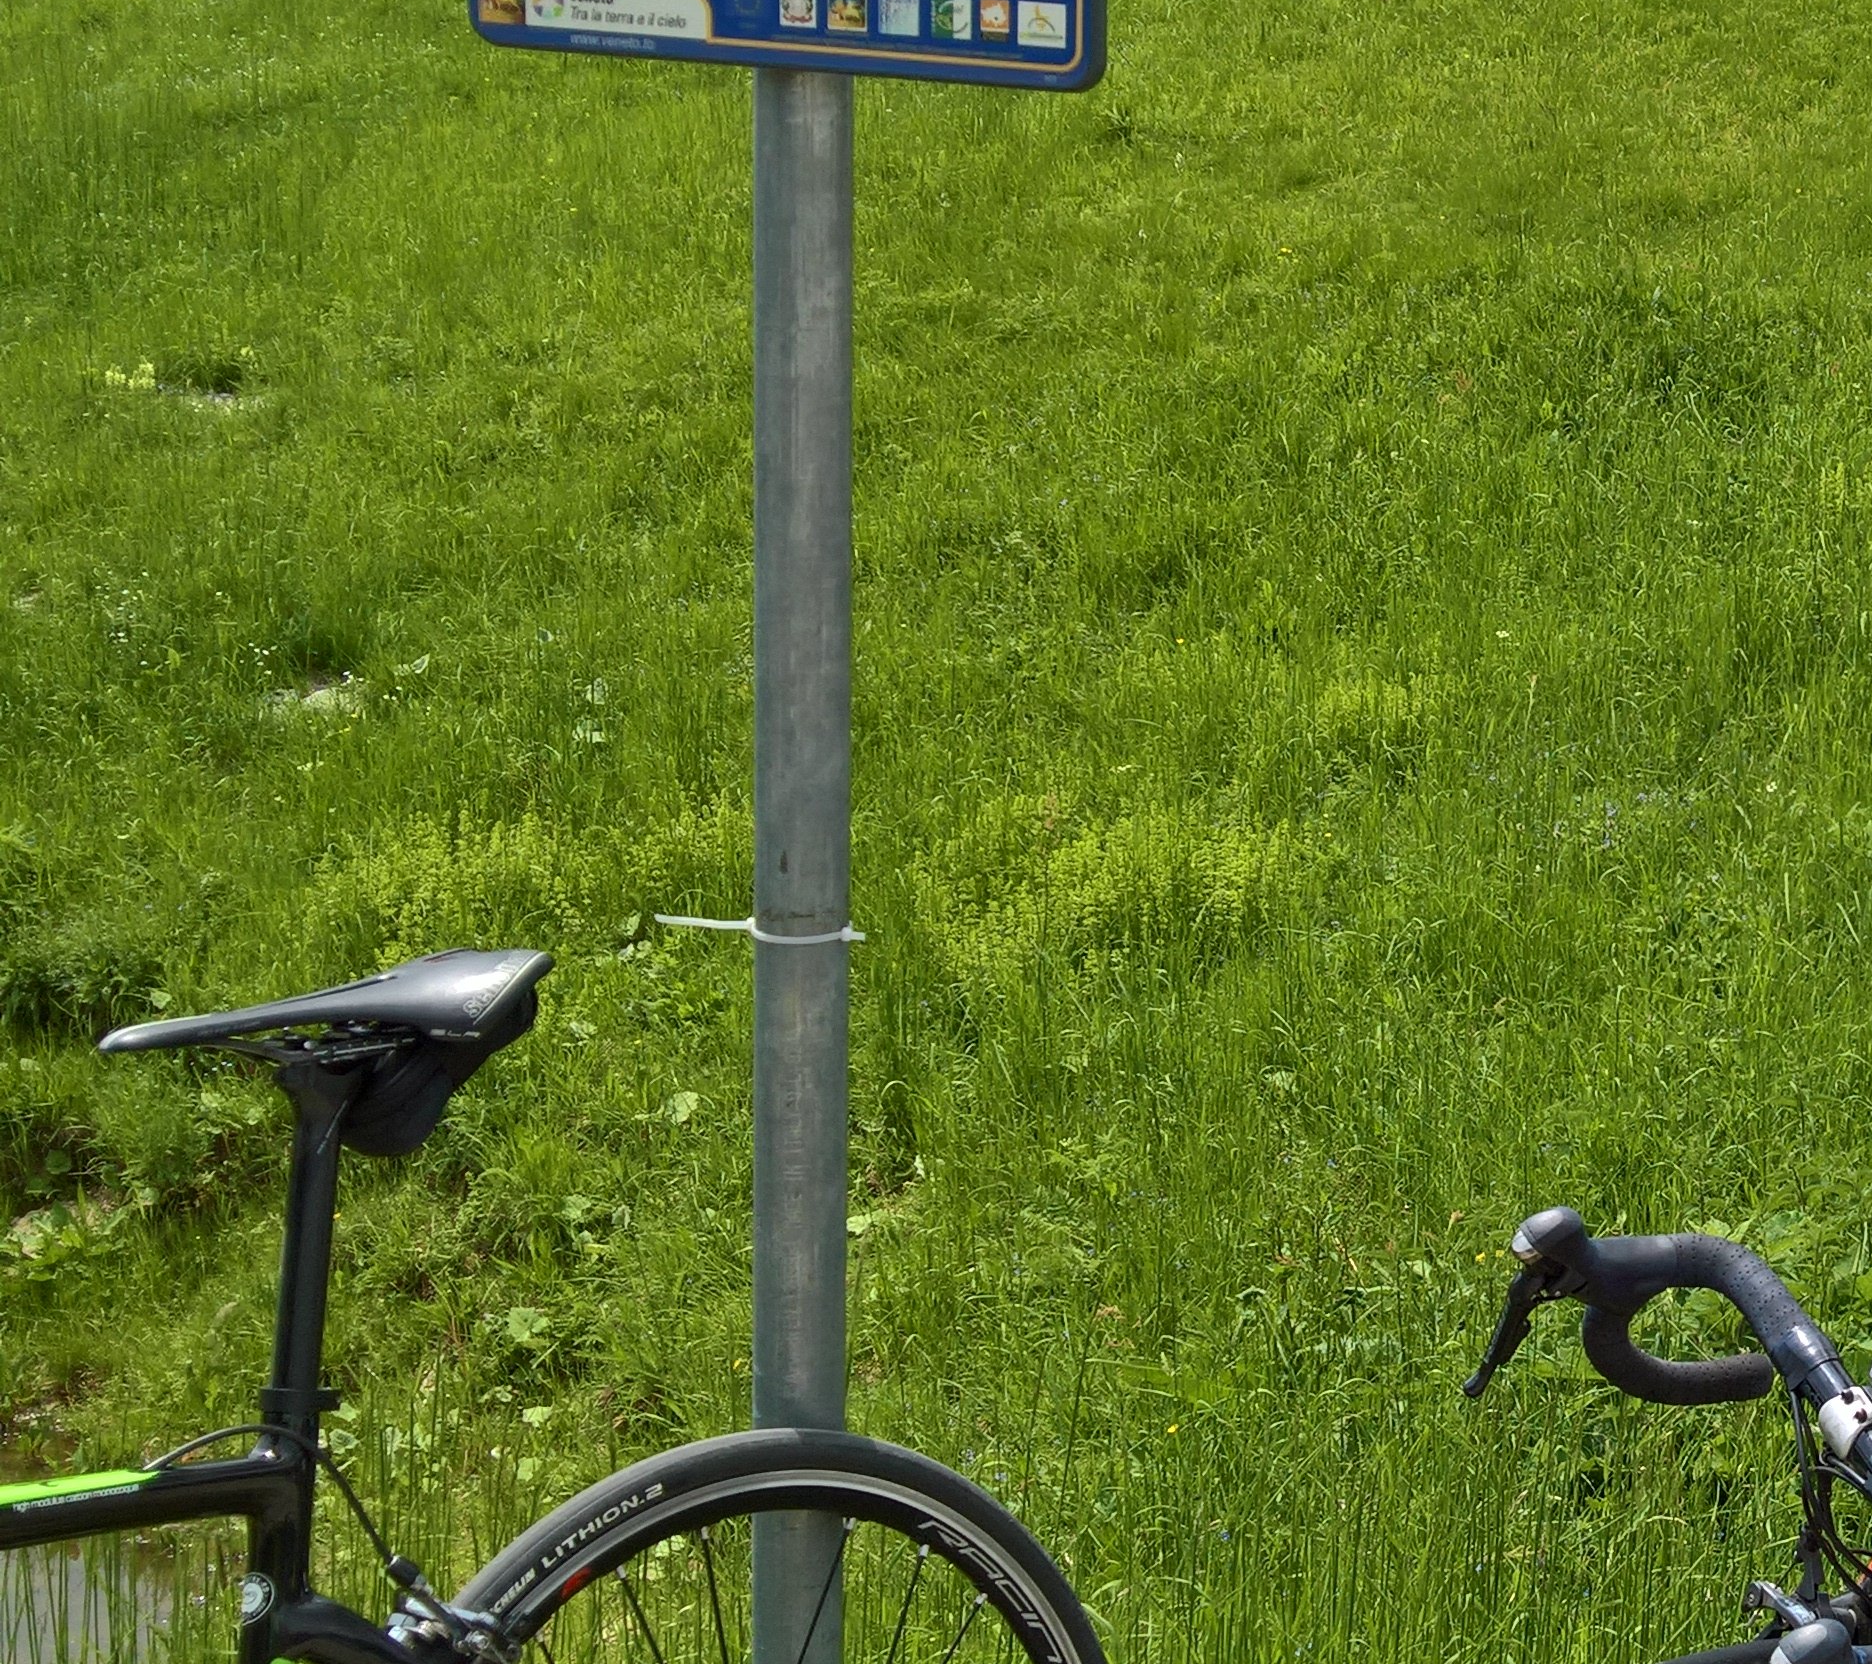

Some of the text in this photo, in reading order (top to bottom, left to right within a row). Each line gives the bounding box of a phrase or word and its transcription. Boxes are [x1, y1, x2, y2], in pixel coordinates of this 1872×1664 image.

[571, 6, 588, 21] Tra
[492, 1483, 663, 1614] CHELIN LITHION.2
